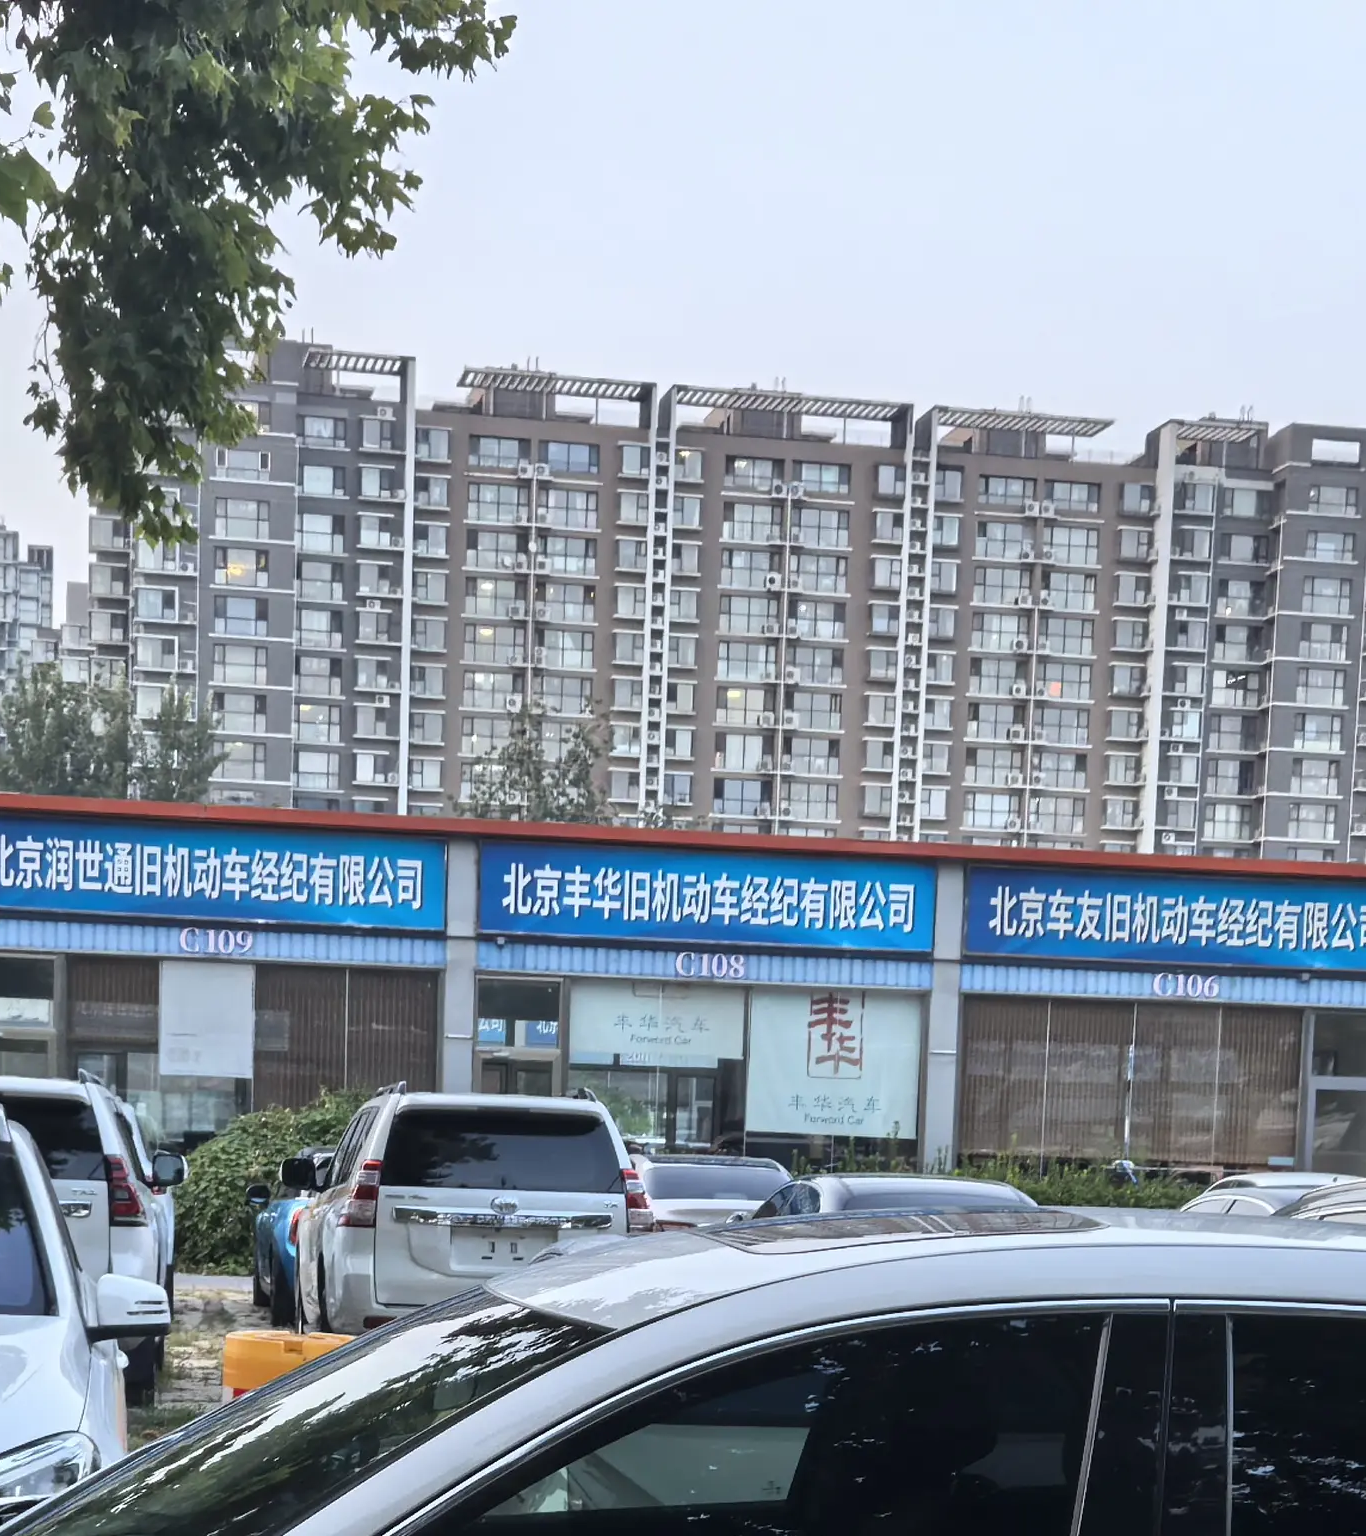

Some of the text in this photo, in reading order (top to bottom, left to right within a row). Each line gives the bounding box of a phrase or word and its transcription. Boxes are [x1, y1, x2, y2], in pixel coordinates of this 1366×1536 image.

[502, 862, 915, 932] 北京丰华旧机动车经纪有限公司
[179, 926, 254, 956] C109
[675, 951, 746, 980] C108
[1152, 972, 1221, 999] C106
